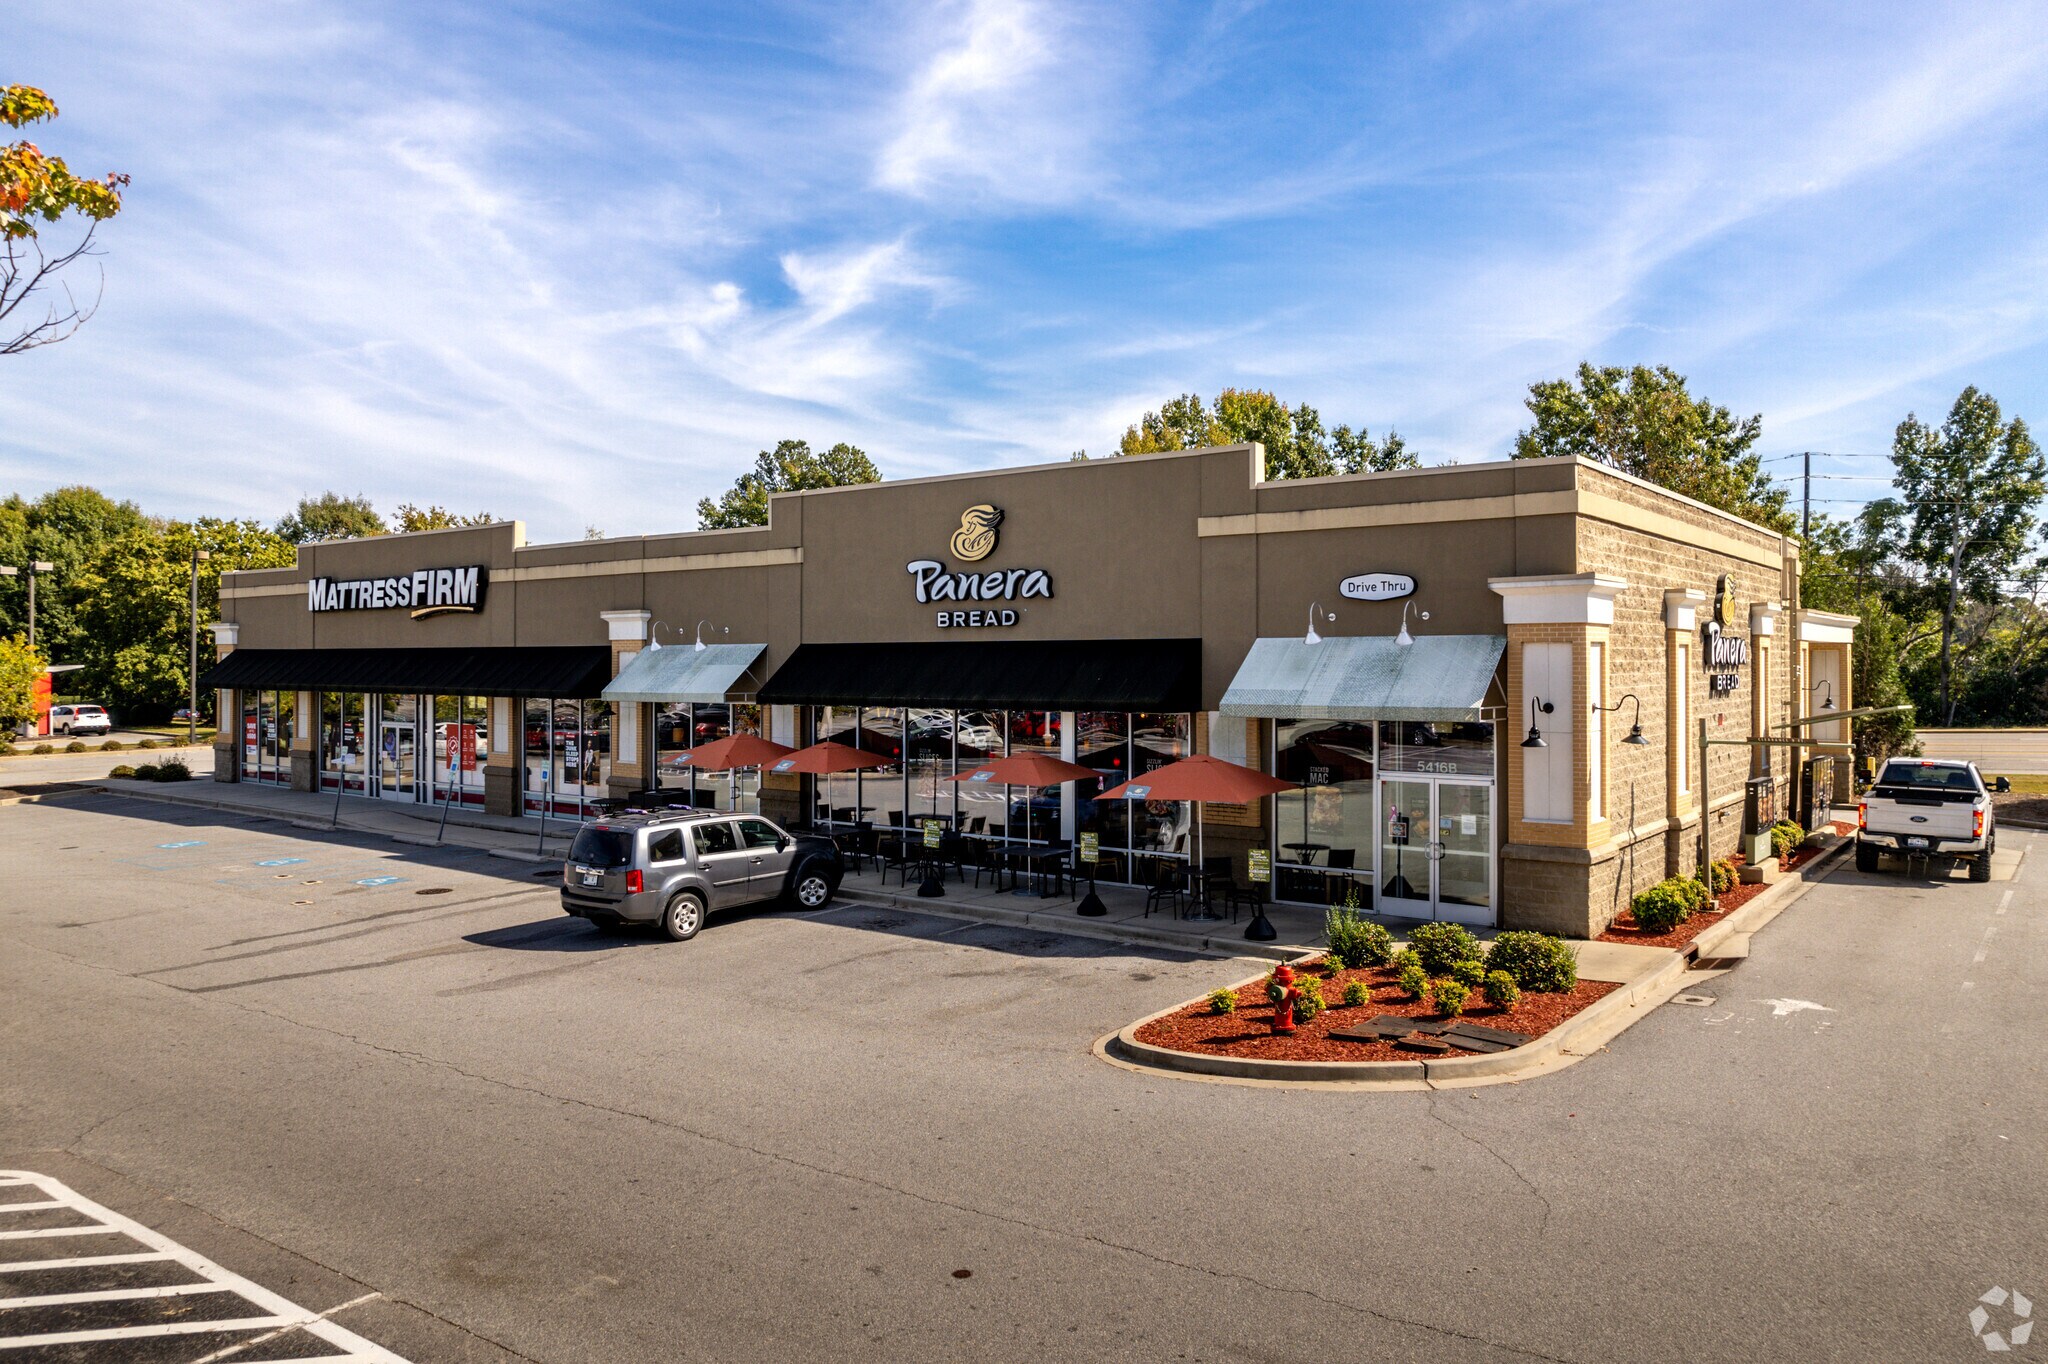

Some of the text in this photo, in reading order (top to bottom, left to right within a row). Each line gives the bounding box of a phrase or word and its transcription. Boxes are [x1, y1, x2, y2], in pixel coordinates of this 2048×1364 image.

[906, 559, 1052, 603] Panera
[1348, 580, 1406, 593] Drive Thru
[936, 609, 1017, 628] BREAD
[1708, 621, 1747, 666] Panera
[1717, 674, 1740, 691] BREAD
[1417, 760, 1457, 774] 5416B
[1309, 772, 1329, 784] MAC
